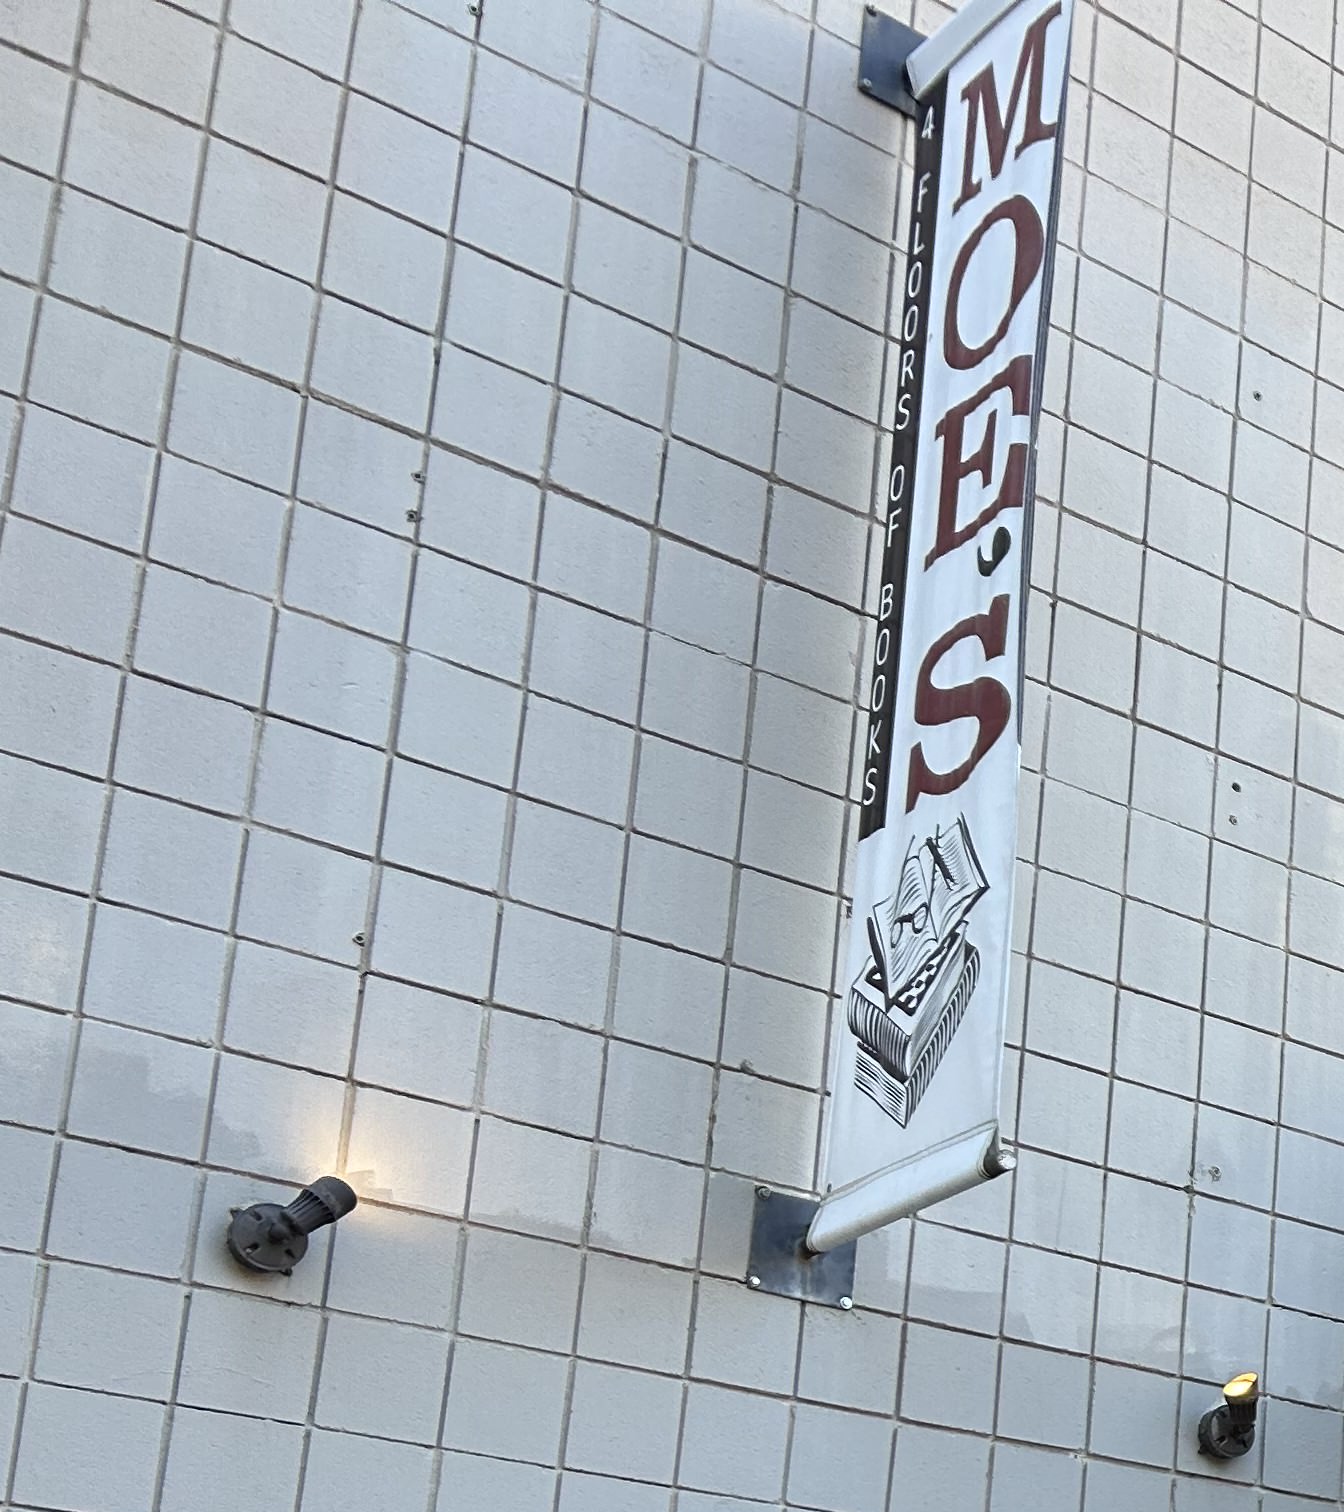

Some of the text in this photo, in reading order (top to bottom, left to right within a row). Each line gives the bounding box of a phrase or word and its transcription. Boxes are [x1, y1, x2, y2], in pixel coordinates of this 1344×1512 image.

[863, 104, 935, 806] 4 FLOORS OF BOOKS
[906, 6, 1062, 816] MOE'S
